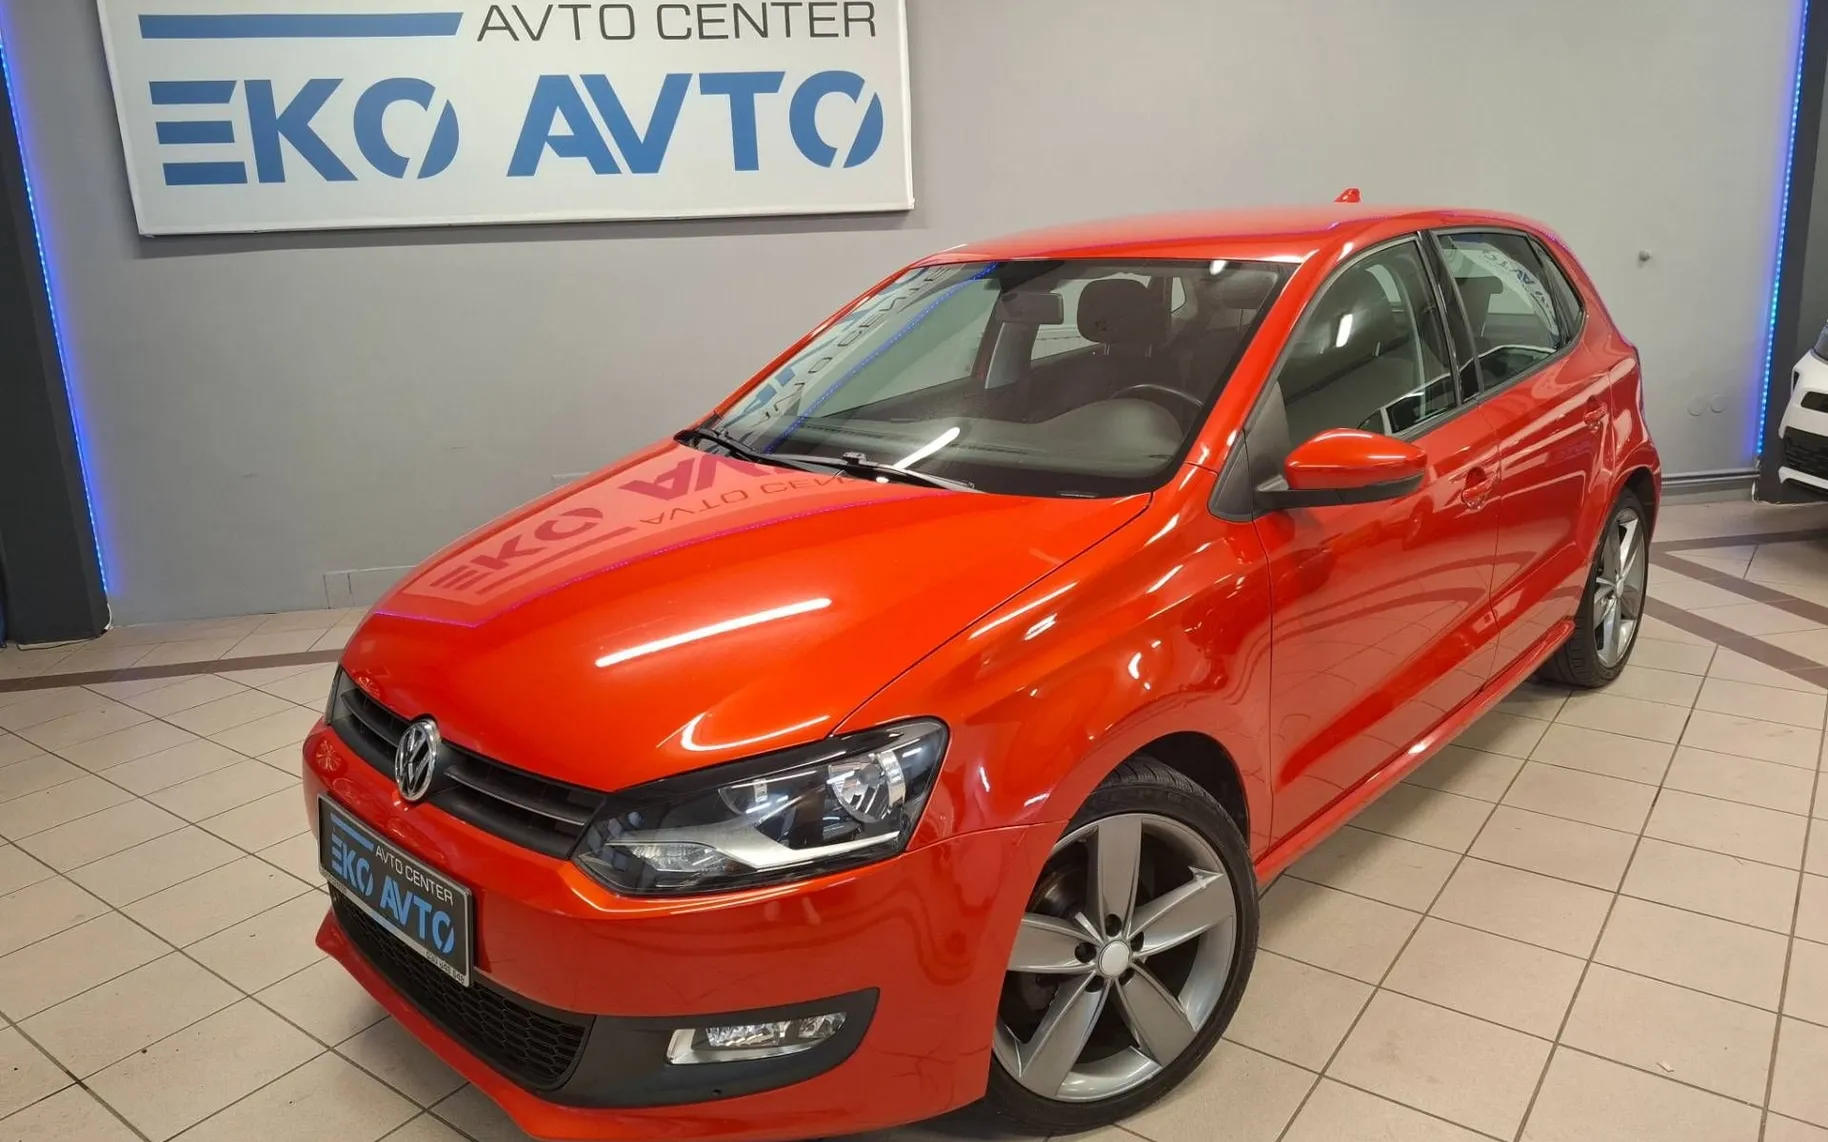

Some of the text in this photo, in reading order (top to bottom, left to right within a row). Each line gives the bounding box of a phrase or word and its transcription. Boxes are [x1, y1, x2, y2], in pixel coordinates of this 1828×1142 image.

[476, 1, 876, 42] AVTO CENTER
[148, 70, 884, 186] EKO AVTO
[331, 832, 455, 954] EKO AVTO
[375, 845, 454, 906] AVTO CENTER
